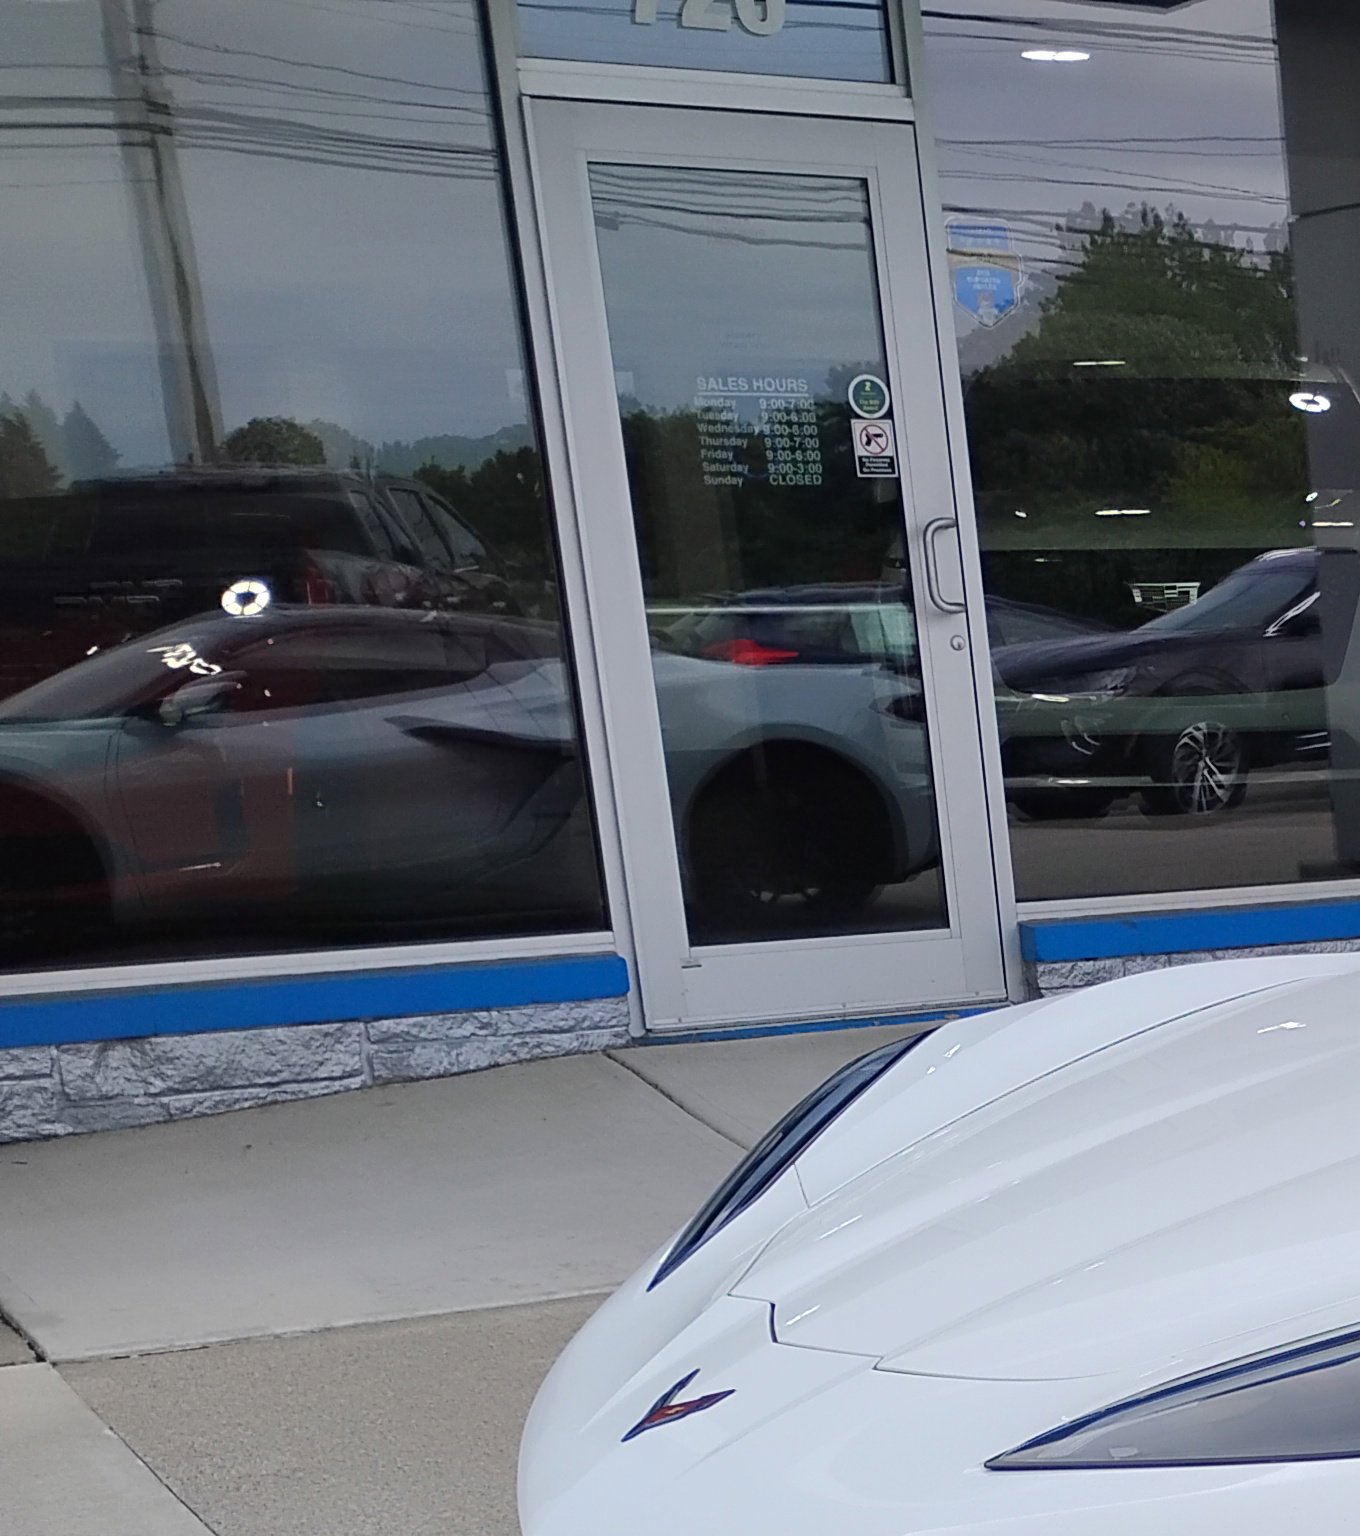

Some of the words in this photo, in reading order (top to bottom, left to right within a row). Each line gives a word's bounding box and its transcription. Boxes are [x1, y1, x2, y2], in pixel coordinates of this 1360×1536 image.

[696, 377, 749, 391] SALES
[752, 377, 808, 392] HOURS
[694, 396, 737, 410] Monday
[759, 398, 815, 410] 9:00-7:00
[697, 409, 739, 422] Tuesday
[761, 411, 816, 423] 9:00-6:00
[696, 422, 760, 435] Wednesday
[699, 435, 748, 448] Thursday
[764, 437, 820, 448] 9:00-7:00
[700, 449, 734, 462] Friday
[766, 450, 821, 461] 9:00-6:00
[702, 461, 749, 474] Saturday
[768, 463, 823, 474] 9:00-3:00
[703, 474, 744, 488] Sunday
[769, 474, 823, 486] CLOSED
